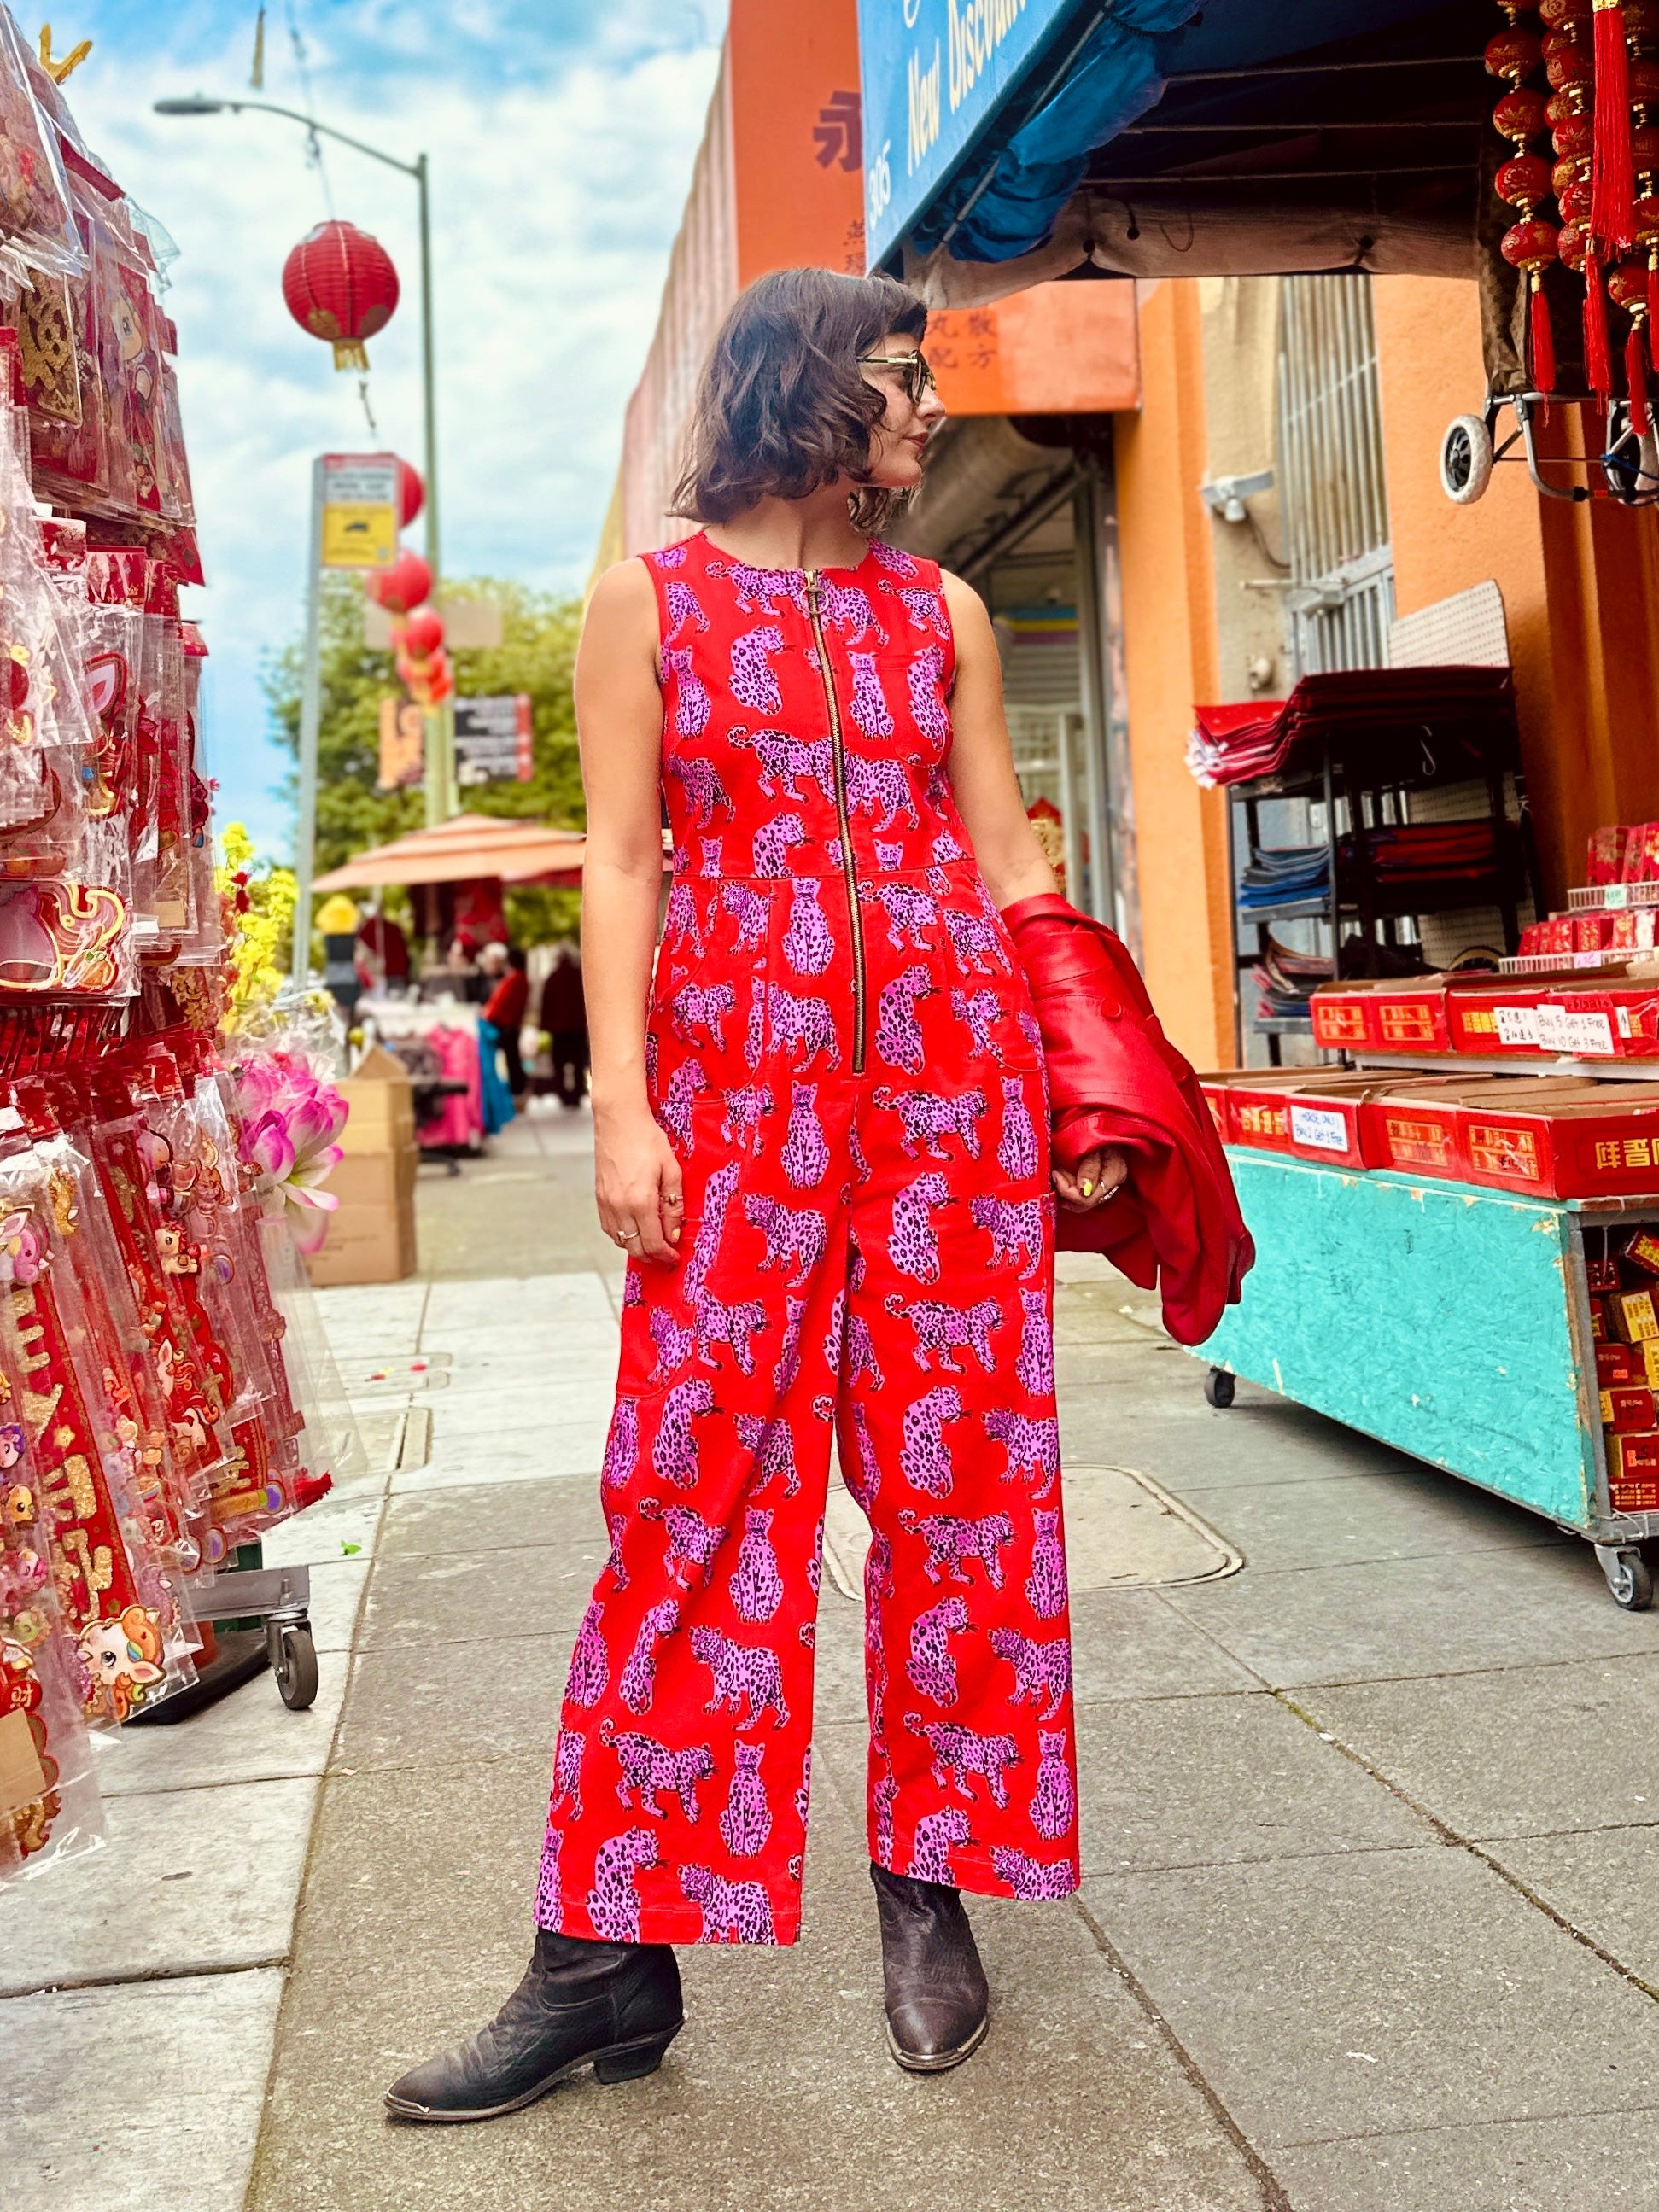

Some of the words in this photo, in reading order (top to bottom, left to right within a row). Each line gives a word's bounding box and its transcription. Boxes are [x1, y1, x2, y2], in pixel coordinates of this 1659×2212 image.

[908, 38, 939, 177] New
[948, 0, 1026, 114] Discou
[1538, 1014, 1555, 1032] Buy
[1556, 1015, 1563, 1028] 5
[1565, 1017, 1579, 1029] Get
[1587, 1018, 1605, 1029] Free
[1539, 1034, 1556, 1048] Buy
[1558, 1036, 1567, 1047] 10
[1590, 1039, 1608, 1050] Free
